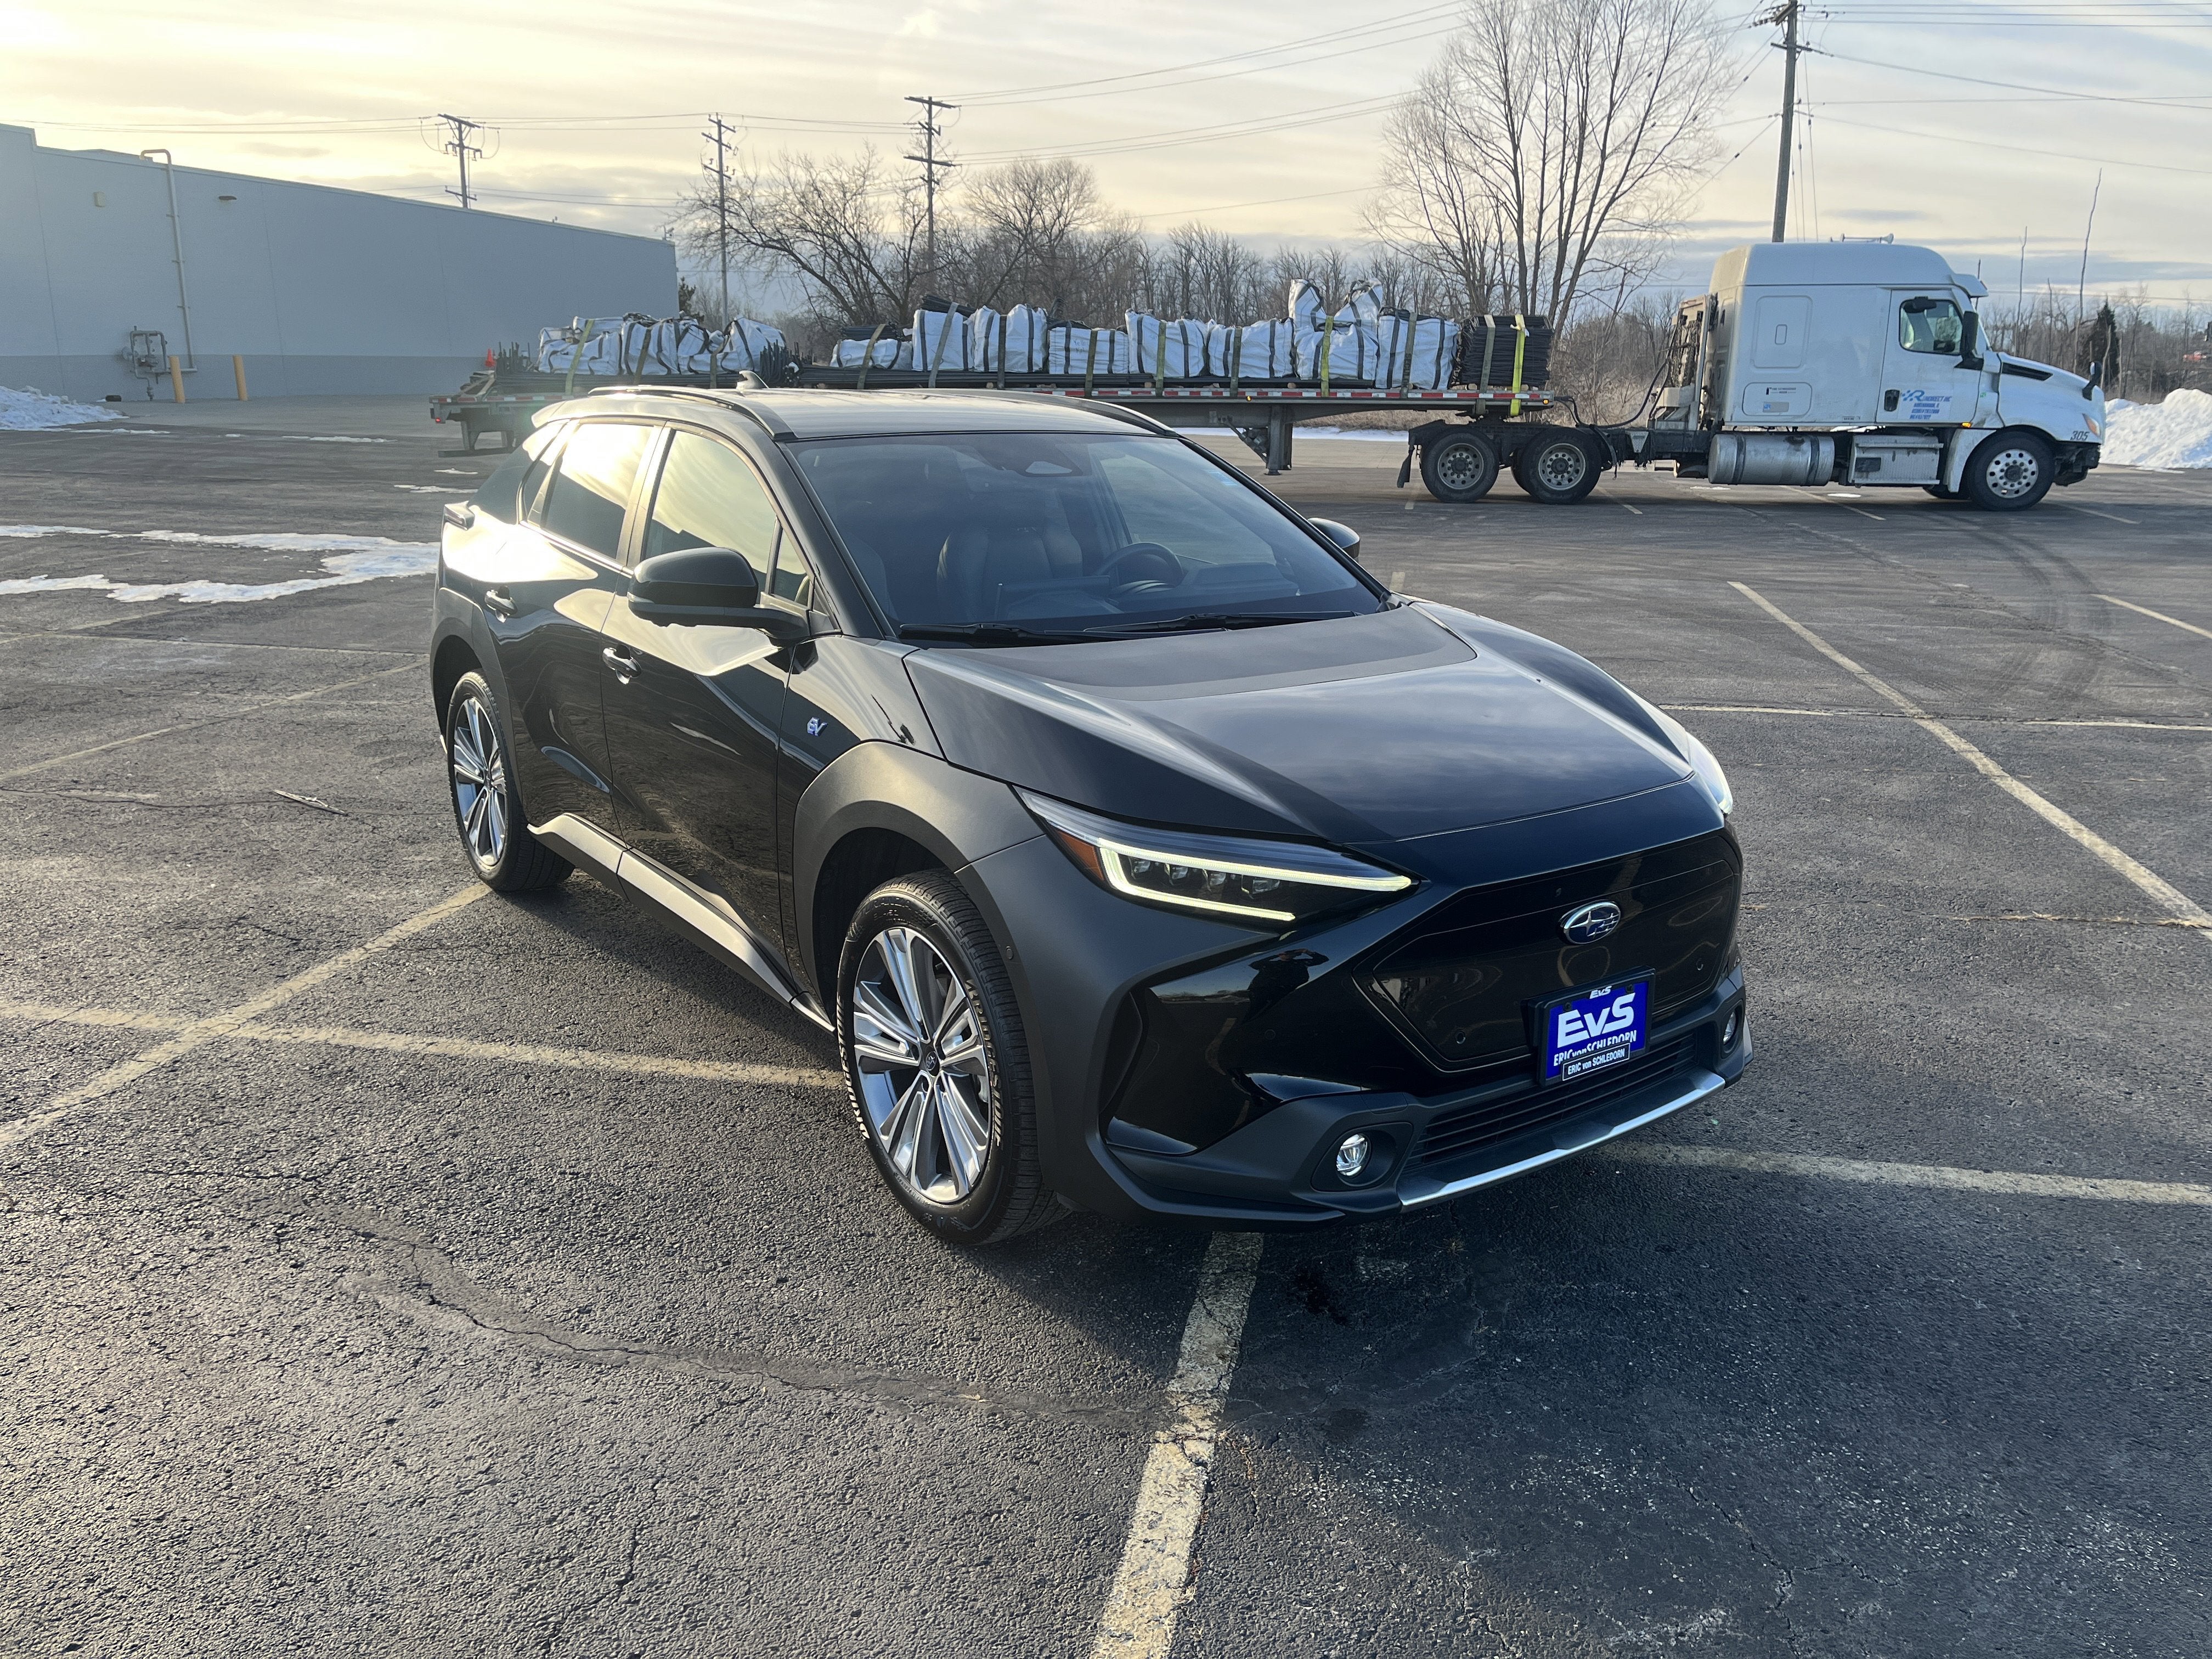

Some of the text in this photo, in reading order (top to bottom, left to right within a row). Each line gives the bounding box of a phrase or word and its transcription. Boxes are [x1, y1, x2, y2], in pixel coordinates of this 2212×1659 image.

[2070, 430, 2089, 441] 305
[1568, 1048, 1625, 1075] ERIC von SCHLEDORN
